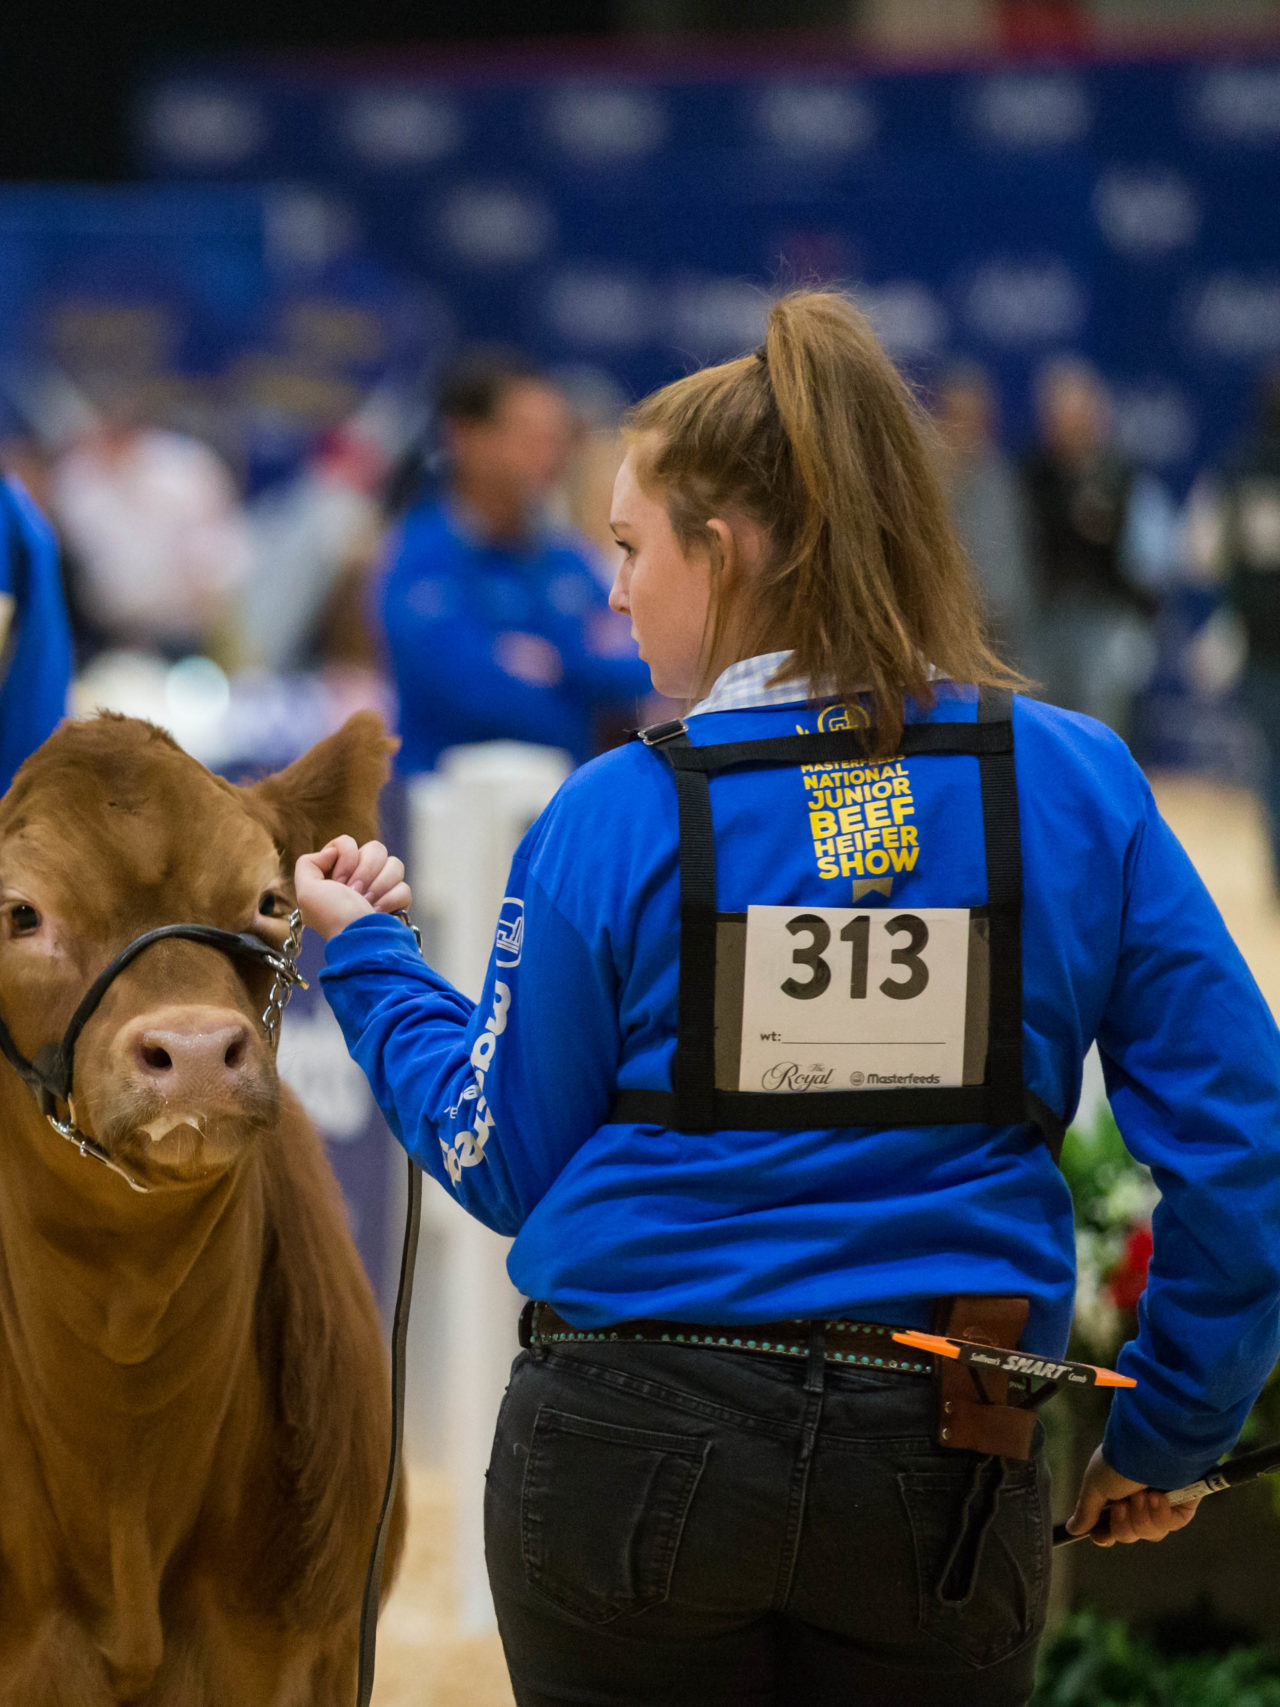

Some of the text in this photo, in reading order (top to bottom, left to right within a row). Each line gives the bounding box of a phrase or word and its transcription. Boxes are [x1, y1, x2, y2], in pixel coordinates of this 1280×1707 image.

[803, 763, 909, 790] NATIONAL
[808, 777, 912, 810] JUNIOR
[809, 796, 915, 839] BEEF
[814, 825, 919, 857] HEIFER
[817, 847, 920, 879] SHOW
[780, 913, 930, 1000] 313
[760, 1031, 782, 1042] wt:
[761, 1061, 836, 1092] Royal
[867, 1073, 940, 1084] Masterfeeds
[1001, 1355, 1067, 1379] SMART
